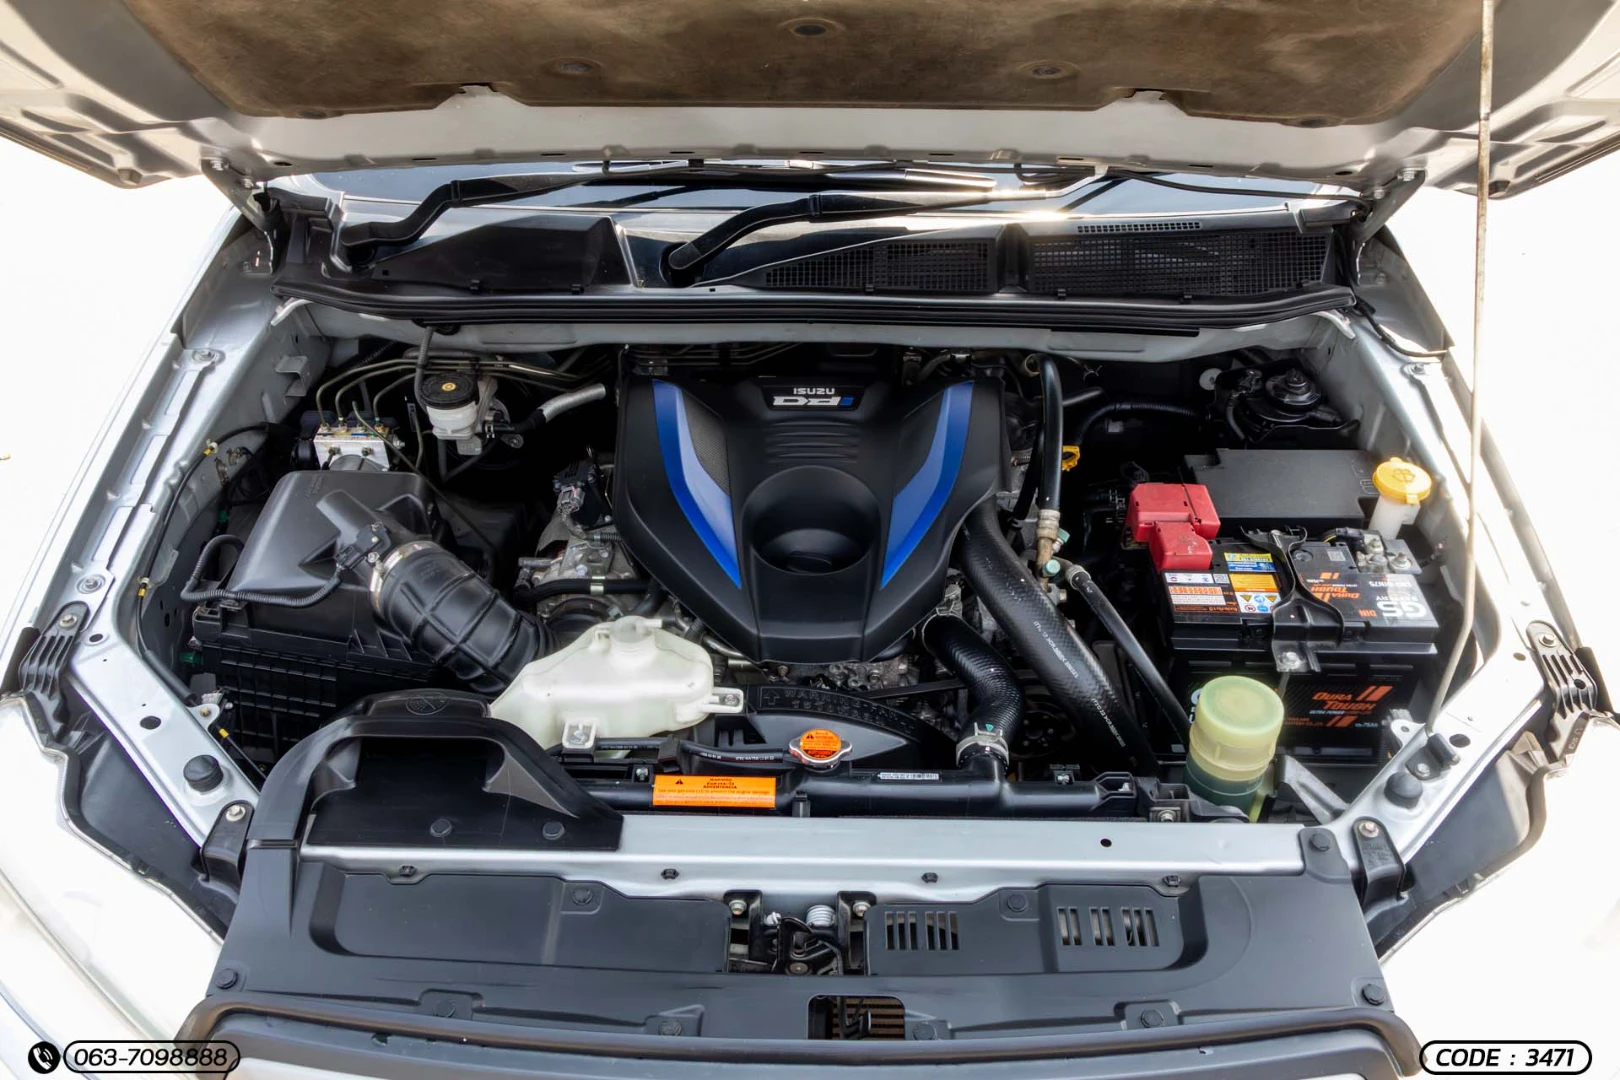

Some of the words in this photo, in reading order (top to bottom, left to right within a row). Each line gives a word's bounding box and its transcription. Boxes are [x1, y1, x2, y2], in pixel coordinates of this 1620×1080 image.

[793, 387, 835, 395] ISUZU
[1331, 592, 1360, 600] DURA
[1358, 609, 1378, 617] DIN
[1376, 600, 1428, 618] GS
[1312, 691, 1353, 701] DURA
[1323, 700, 1377, 711] TOUGH
